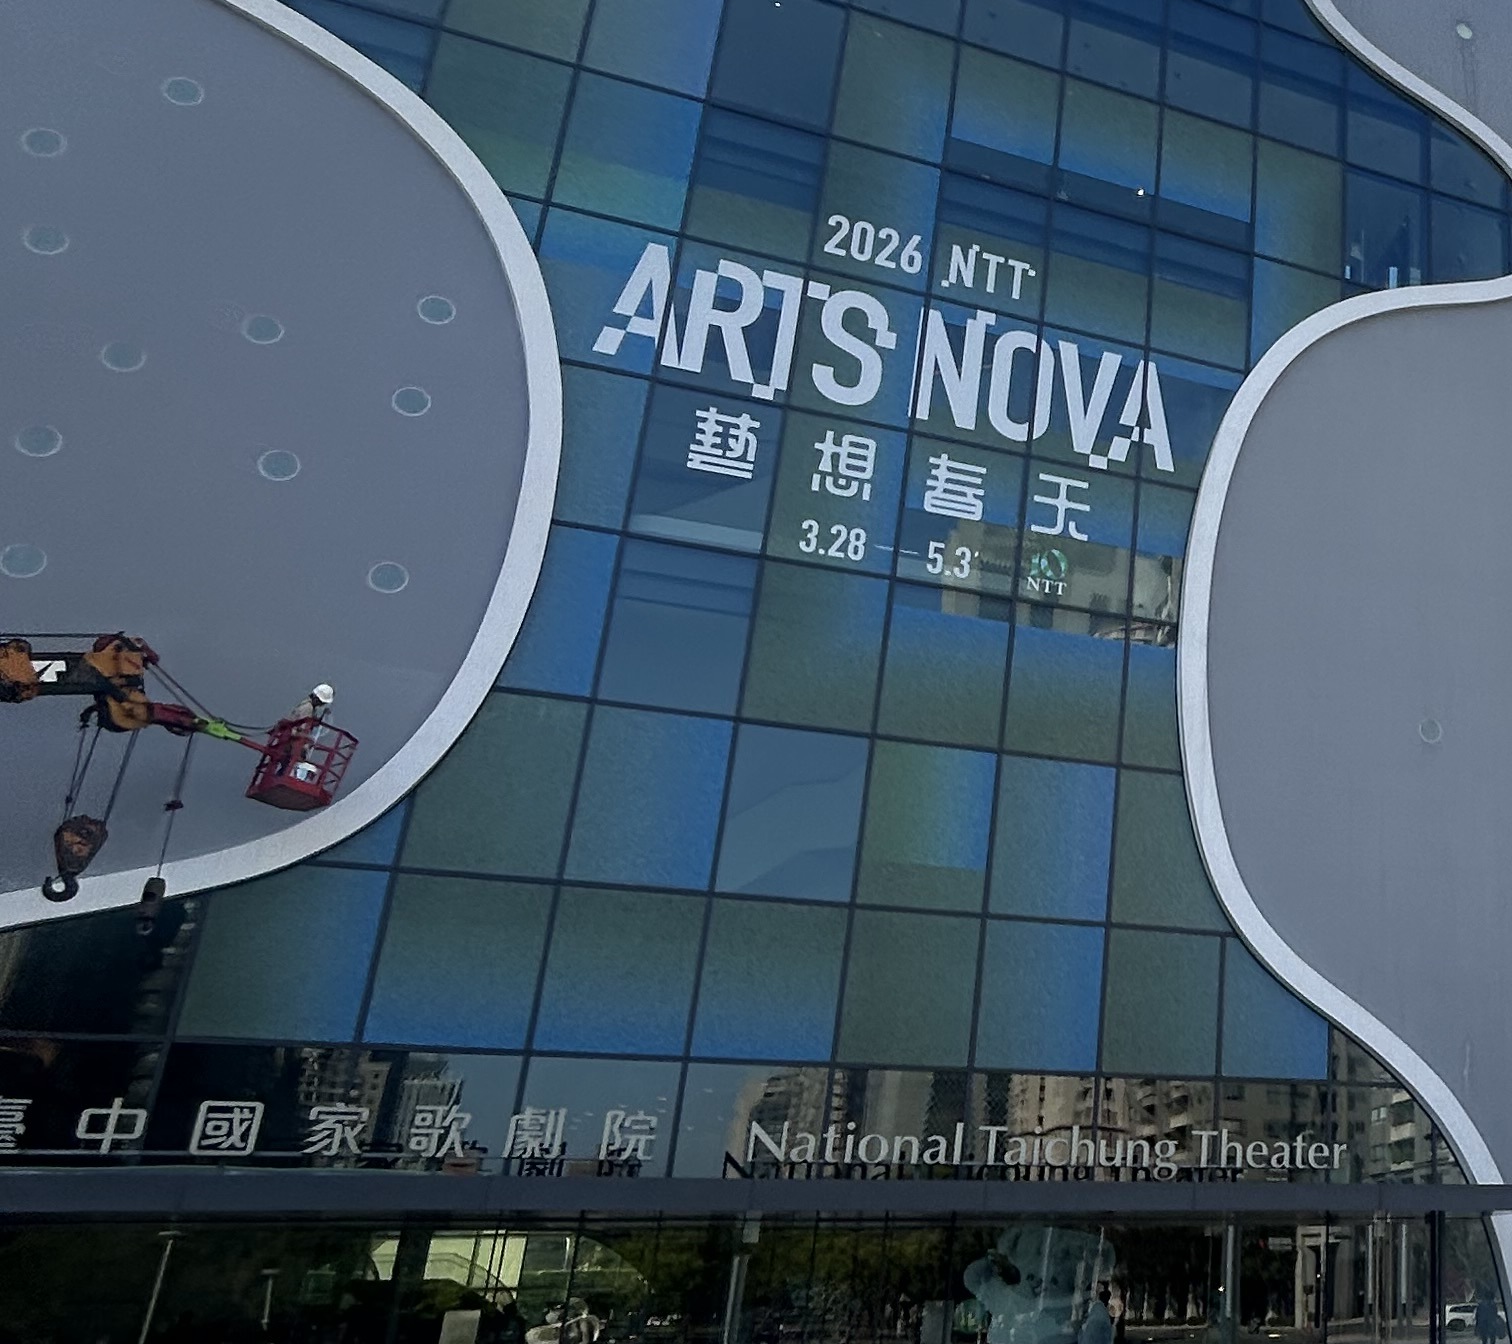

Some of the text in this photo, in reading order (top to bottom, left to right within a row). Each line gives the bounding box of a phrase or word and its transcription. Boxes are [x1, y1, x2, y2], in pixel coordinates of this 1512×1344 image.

[823, 214, 1036, 301] 2026 NTT
[592, 241, 1176, 473] ARTS NOVA
[687, 406, 1091, 542] 藝想春天
[799, 519, 867, 561] 3.28
[1026, 576, 1067, 595] NTT
[746, 1120, 1347, 1182] National Taichung Theater
